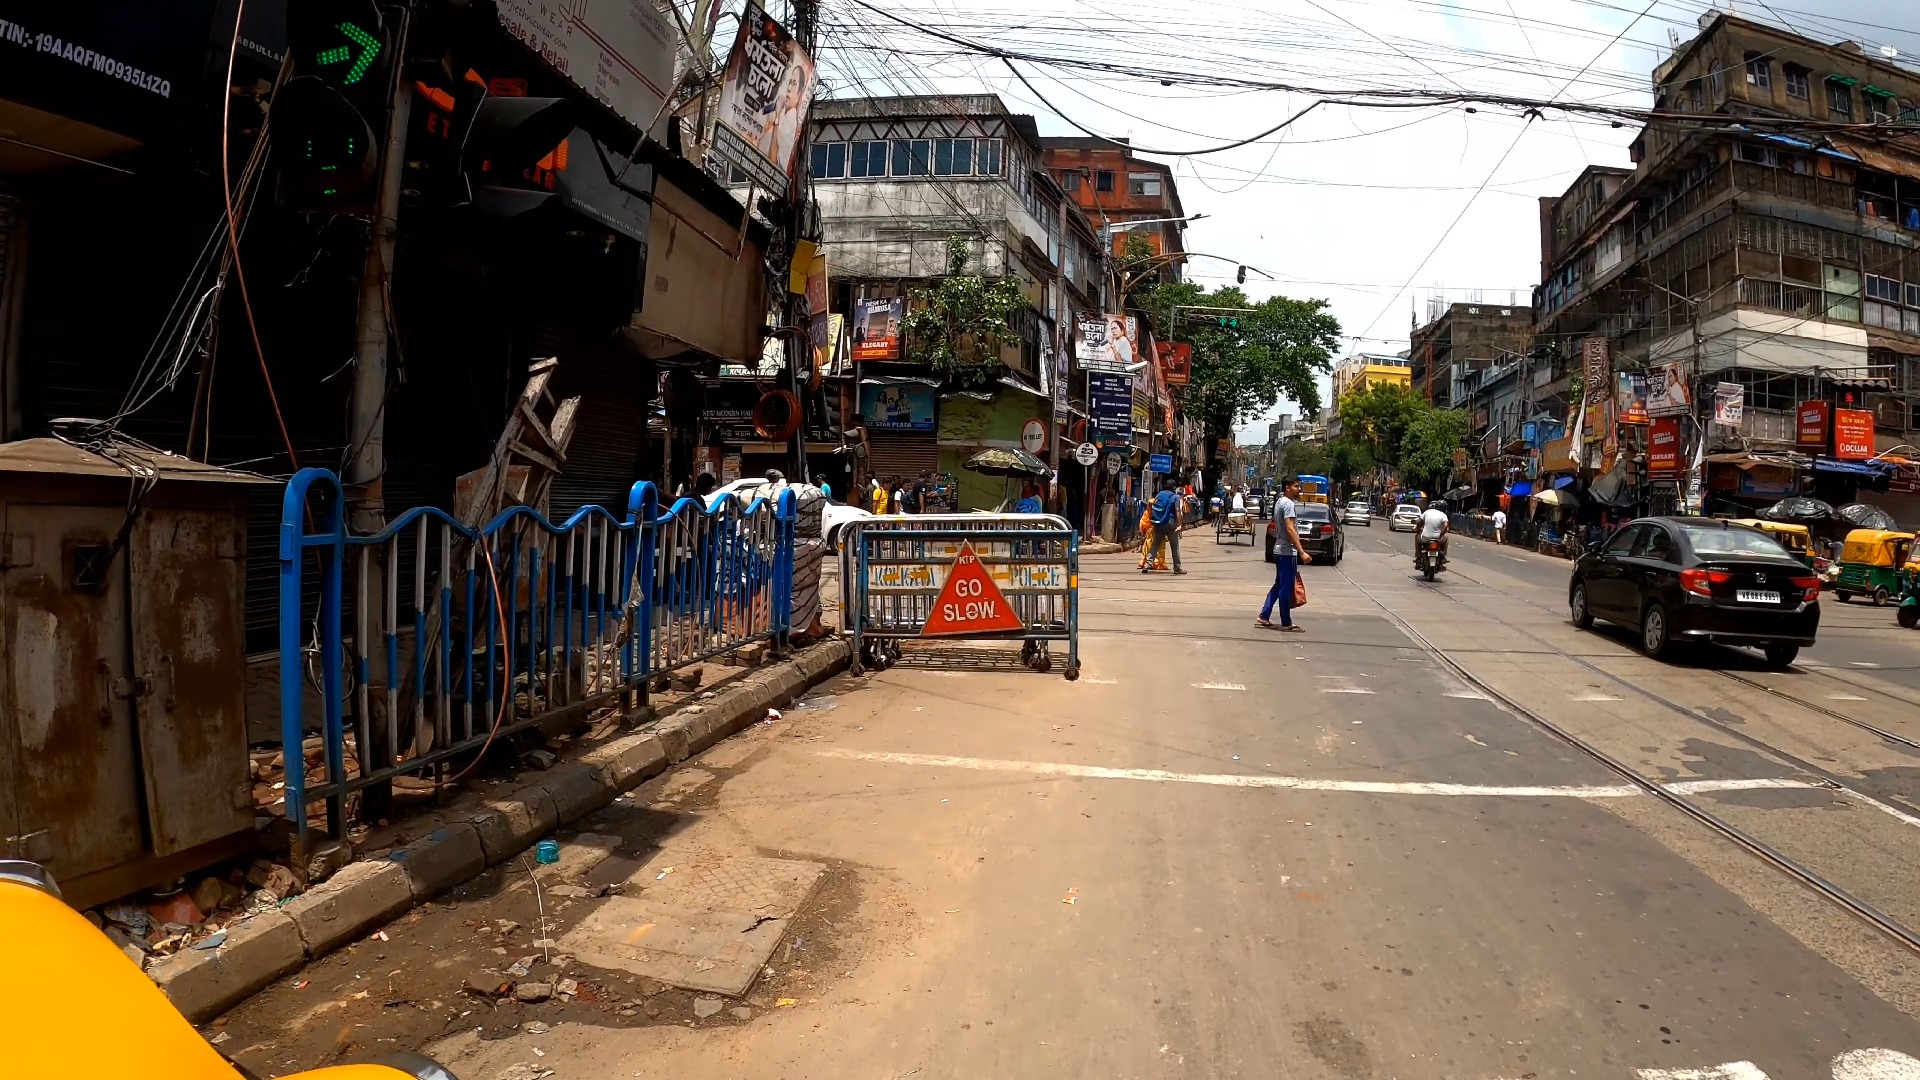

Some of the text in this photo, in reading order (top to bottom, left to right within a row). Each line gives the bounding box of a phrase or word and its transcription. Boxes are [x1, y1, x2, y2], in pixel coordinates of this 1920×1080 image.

[541, 41, 569, 73] Retail
[1846, 444, 1868, 453] DOLLAR
[875, 566, 1060, 587] KOLKATA POLICE
[955, 578, 982, 598] GO
[943, 599, 997, 622] SLOW
